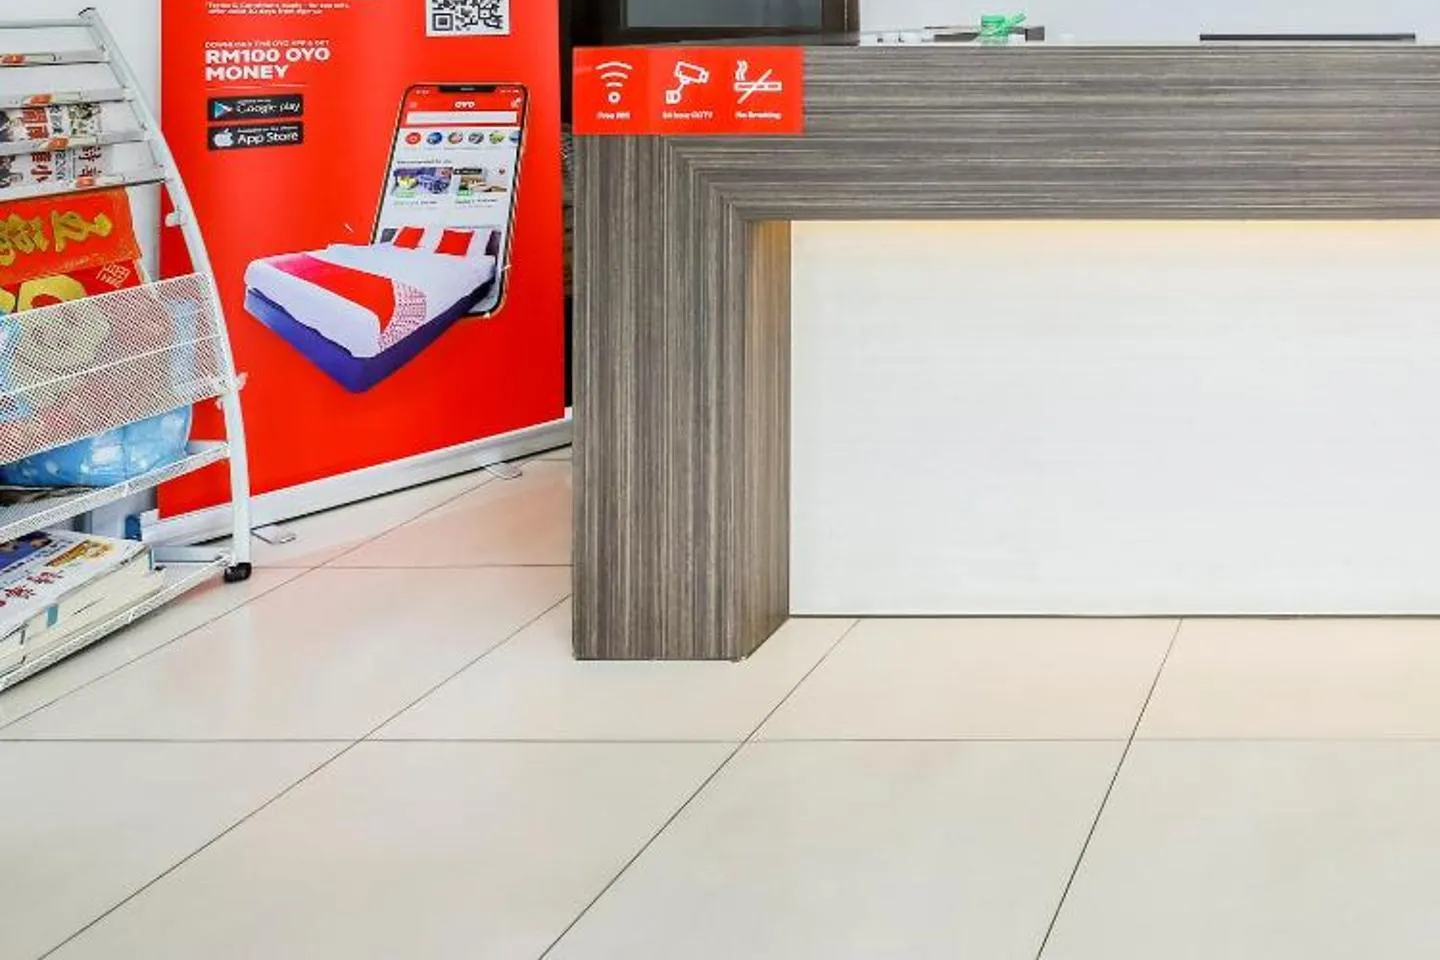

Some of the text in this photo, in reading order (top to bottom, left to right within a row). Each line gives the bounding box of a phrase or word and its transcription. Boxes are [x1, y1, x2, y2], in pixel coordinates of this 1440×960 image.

[205, 47, 331, 64] RM100 OYO
[205, 65, 288, 81] MONEY
[236, 103, 277, 115] Google
[237, 131, 298, 145] App Store
